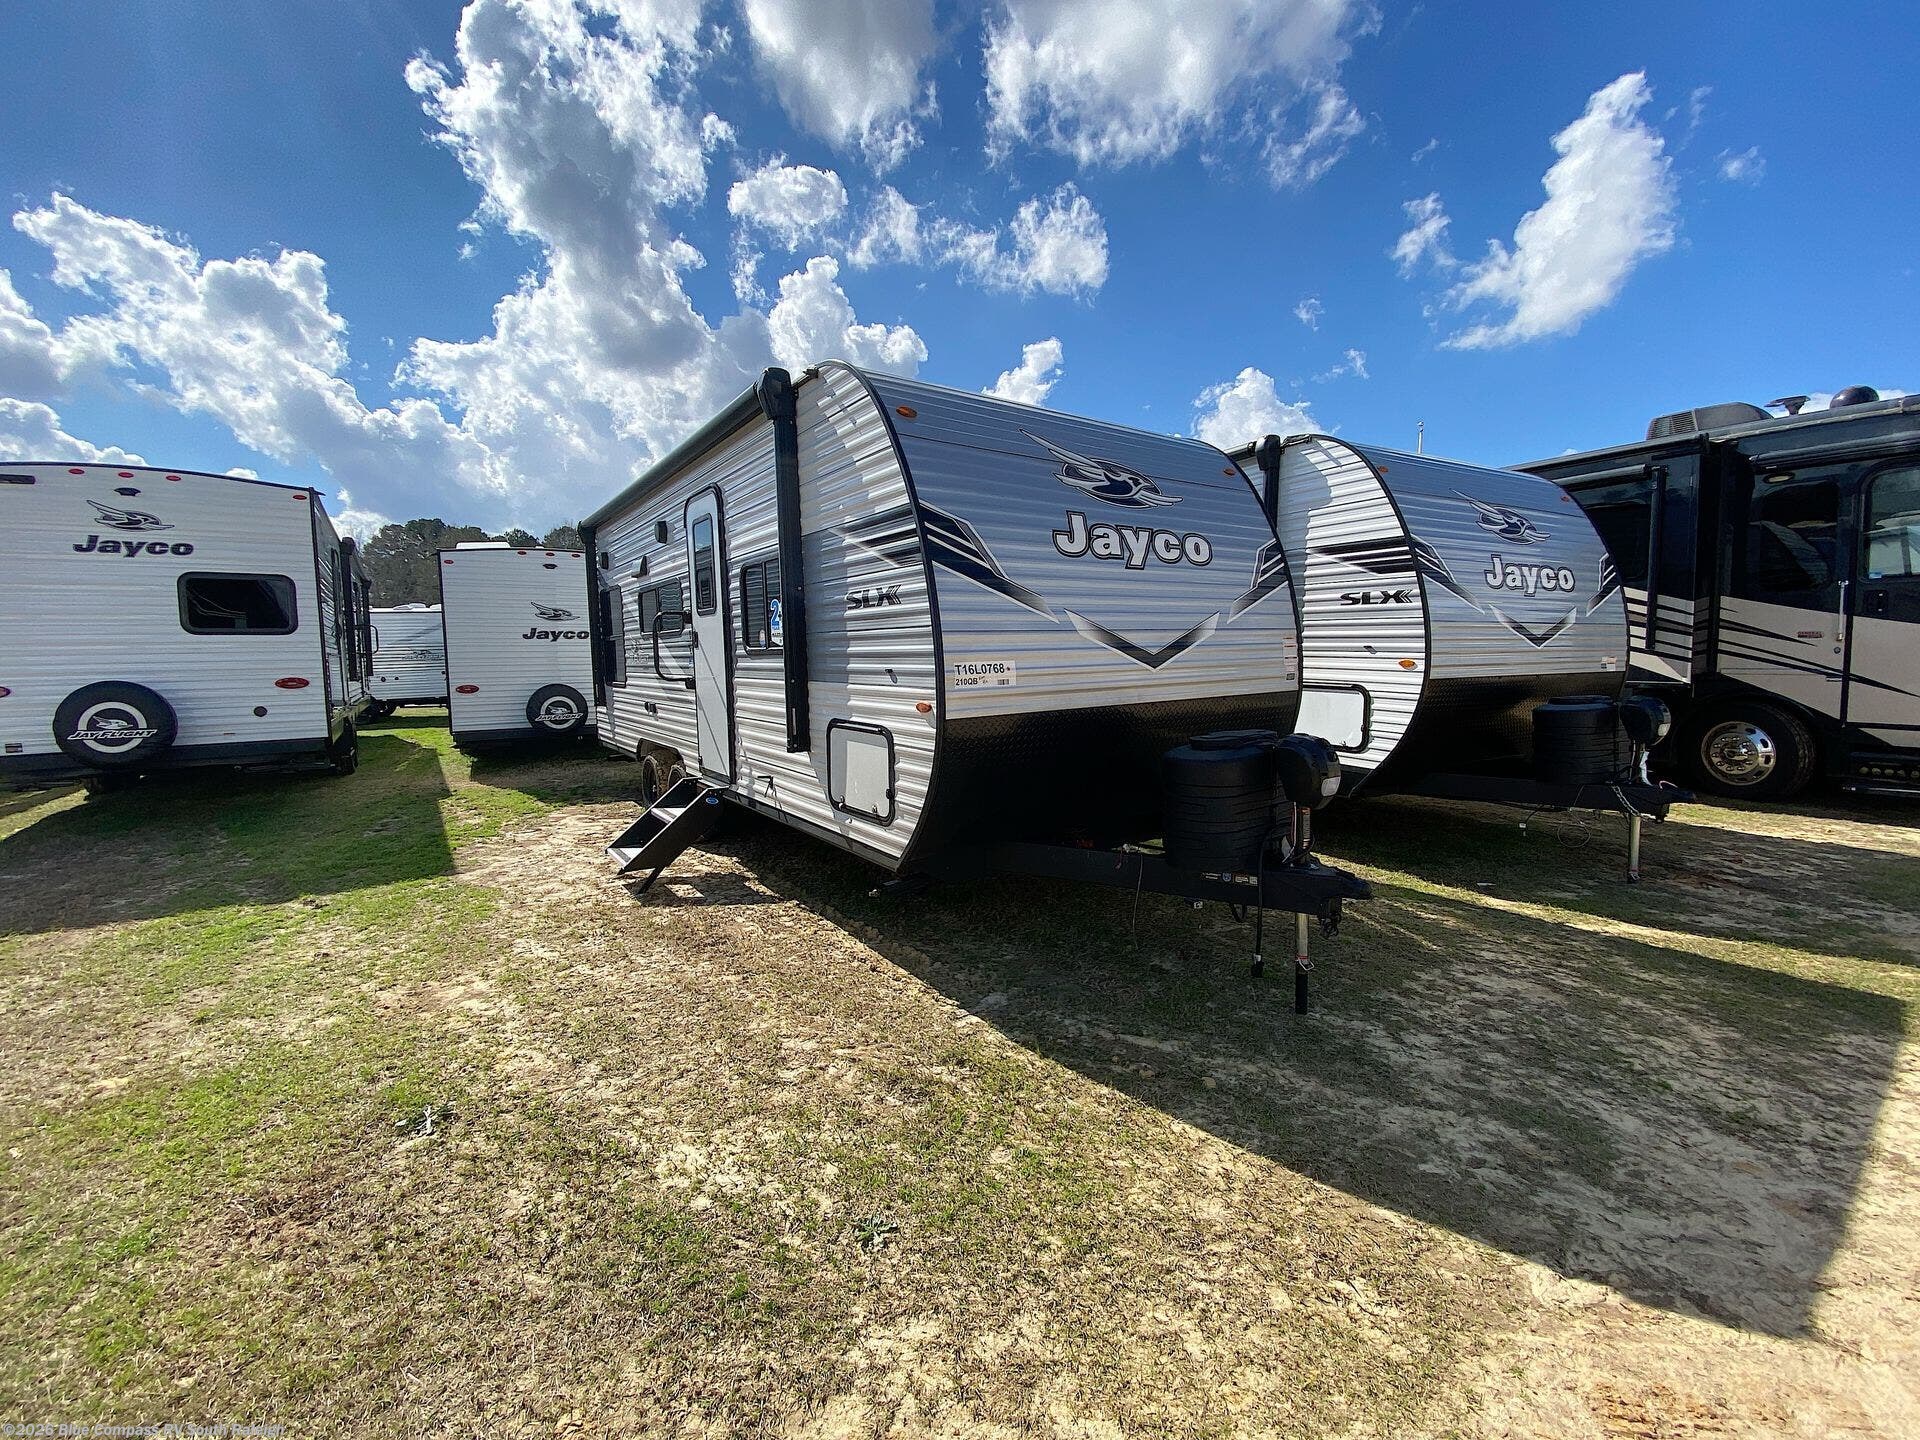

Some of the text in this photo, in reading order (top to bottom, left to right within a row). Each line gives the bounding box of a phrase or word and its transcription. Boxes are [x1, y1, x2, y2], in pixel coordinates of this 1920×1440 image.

[72, 535, 194, 558] Jayco
[1052, 510, 1213, 570] Jayco
[1484, 554, 1575, 597] Jayco
[845, 584, 902, 610] SLX
[1340, 590, 1413, 606] SLX
[522, 628, 590, 642] Jayco
[955, 663, 1005, 675] T16L0768
[955, 678, 978, 686] 210QB
[67, 729, 158, 740] JAY FLIGHT
